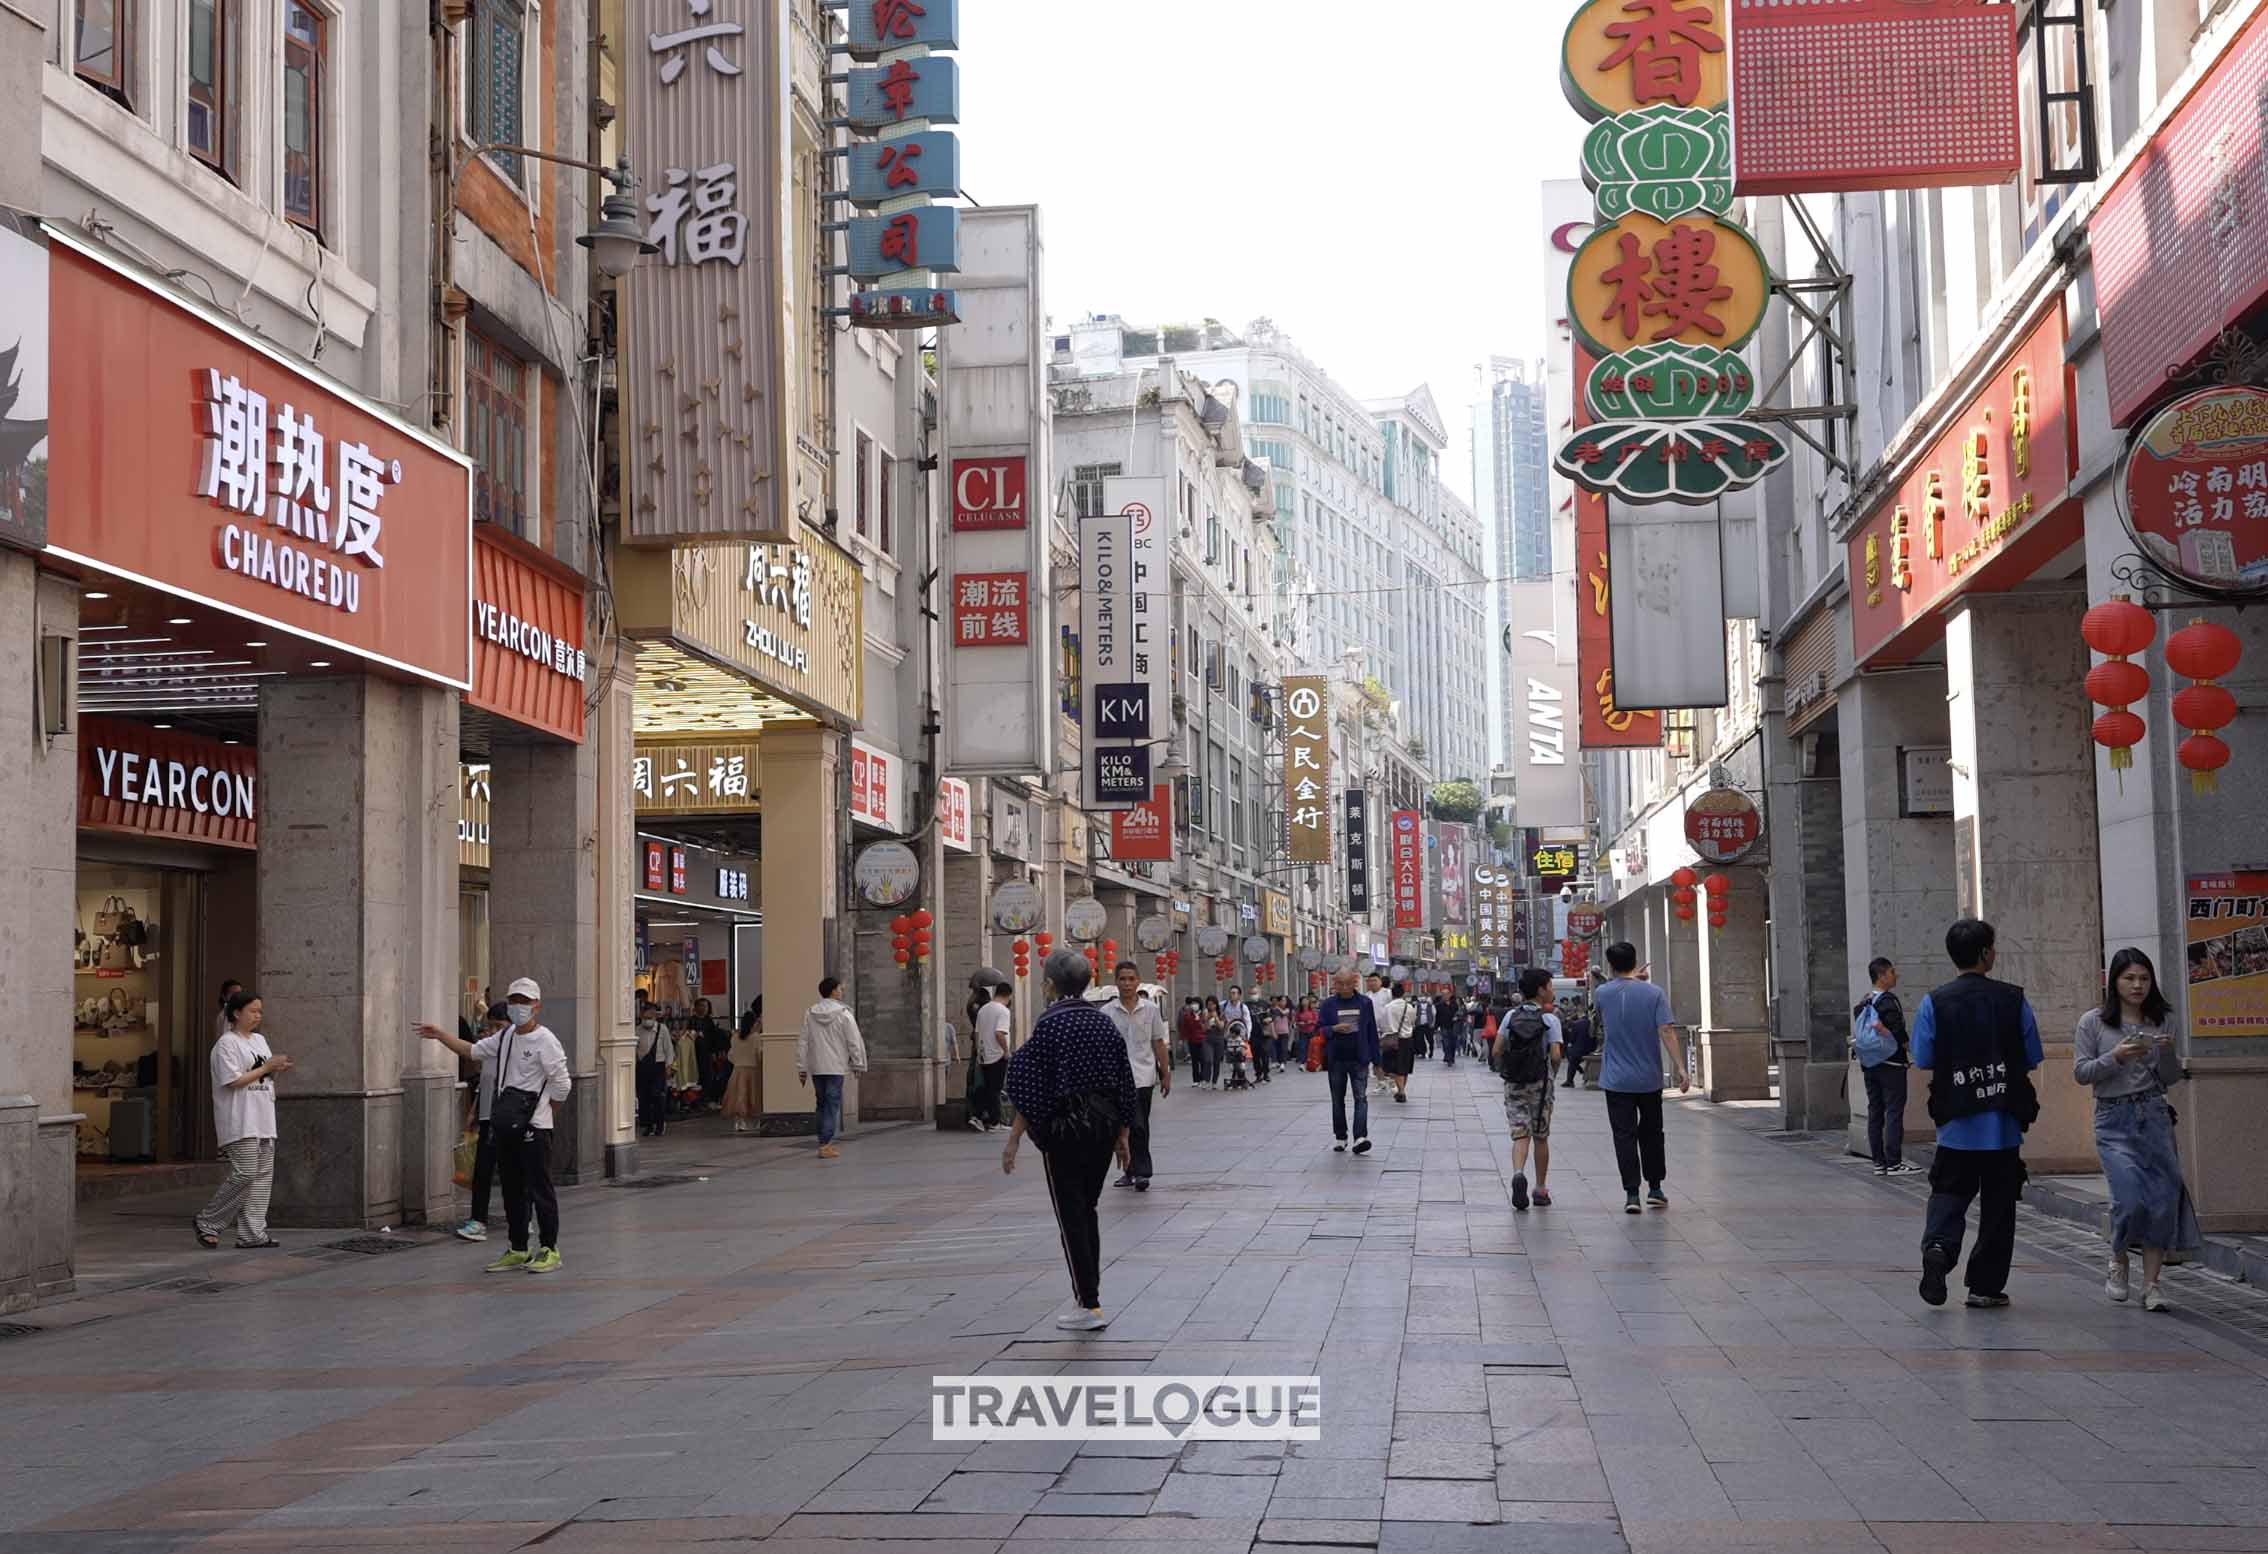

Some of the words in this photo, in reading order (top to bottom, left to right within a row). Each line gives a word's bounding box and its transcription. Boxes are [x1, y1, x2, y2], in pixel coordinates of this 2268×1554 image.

[1677, 374, 1750, 395] 1889
[203, 367, 384, 569] 潮热度
[1573, 439, 1777, 464] 老广州手信
[957, 466, 1021, 511] CL
[222, 524, 360, 614] CHAOREDU
[959, 579, 1020, 608] 潮流
[1097, 531, 1113, 667] KILO&METERS
[477, 599, 552, 667] YEARCON
[959, 612, 1020, 640] 前线
[1101, 698, 1143, 723] KM
[1527, 677, 1565, 765] ANTA
[95, 746, 254, 820] YEARCON
[632, 755, 748, 800] 周六福
[1101, 755, 1132, 766] KILO
[1101, 777, 1144, 788] METERS
[1289, 725, 1324, 830] 人民金行
[1348, 806, 1364, 897] 莱克斯顿
[1533, 849, 1575, 870] 住宿
[1479, 887, 1494, 947] 中国黄金
